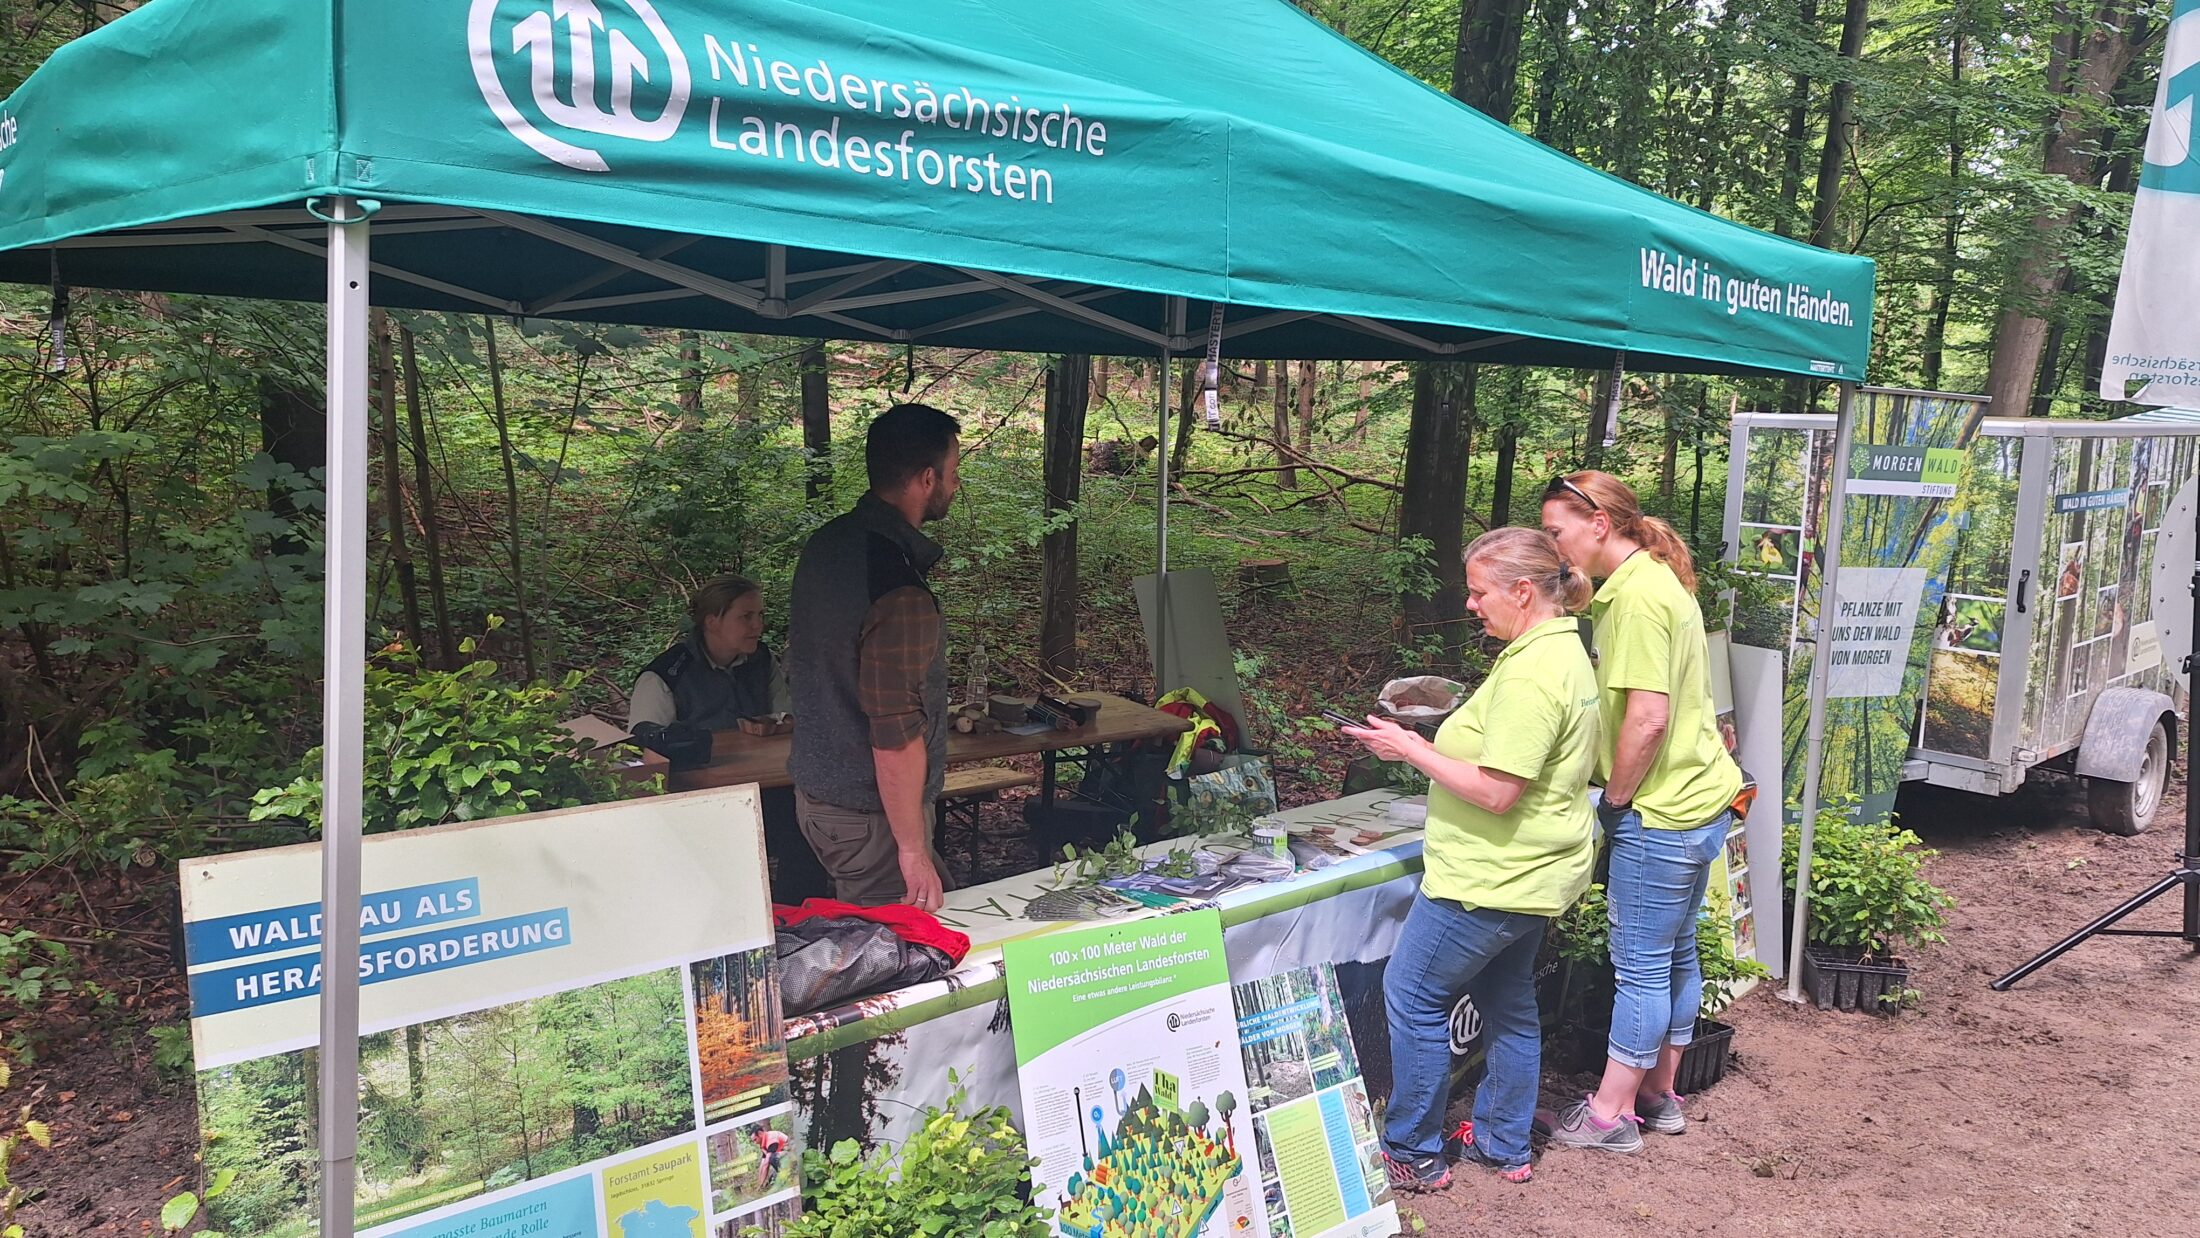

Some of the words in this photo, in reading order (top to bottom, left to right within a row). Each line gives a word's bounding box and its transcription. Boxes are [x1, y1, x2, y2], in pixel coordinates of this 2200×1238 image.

[704, 33, 1108, 157] Niedersächsische
[709, 96, 1054, 204] Landesforsten
[1640, 247, 1697, 297] Wald
[1702, 262, 1720, 301] in
[1726, 277, 1781, 315] guten
[1785, 282, 1854, 328] Händen.
[1873, 455, 1922, 473] MORGEN
[1927, 457, 1958, 474] WALD
[1922, 485, 1952, 495] STIFTUNG
[2062, 497, 2079, 510] WALD
[1841, 602, 1883, 617] PFLANZE
[1884, 602, 1903, 617] MIT
[1832, 626, 1850, 642] UNS
[1853, 626, 1872, 642] DEN
[1874, 626, 1900, 641] WALD
[1831, 650, 1849, 666] VON
[1851, 649, 1891, 665] MORGEN
[228, 900, 402, 951] WALDAU
[415, 888, 475, 920] ALS
[1049, 949, 1070, 966] 100
[1081, 944, 1101, 959] 100
[1104, 938, 1137, 957] Meter
[1139, 931, 1168, 949] Wald
[1169, 929, 1187, 944] der
[236, 917, 564, 1003] HERASFORDERUNG
[1027, 964, 1134, 995] Niedersächsischen
[1136, 947, 1210, 973] Landesforsten
[1072, 993, 1086, 1003] Eine
[1087, 989, 1106, 1000] etwas
[1107, 984, 1128, 996] andere
[1262, 1029, 1275, 1040] VON
[1155, 1085, 1172, 1100] Wald
[1162, 1074, 1176, 1093] ha
[609, 1167, 650, 1188] Forstamt
[652, 1152, 692, 1174] Saupark
[480, 1201, 547, 1231] Baumarten
[521, 1218, 549, 1237] Rolle
